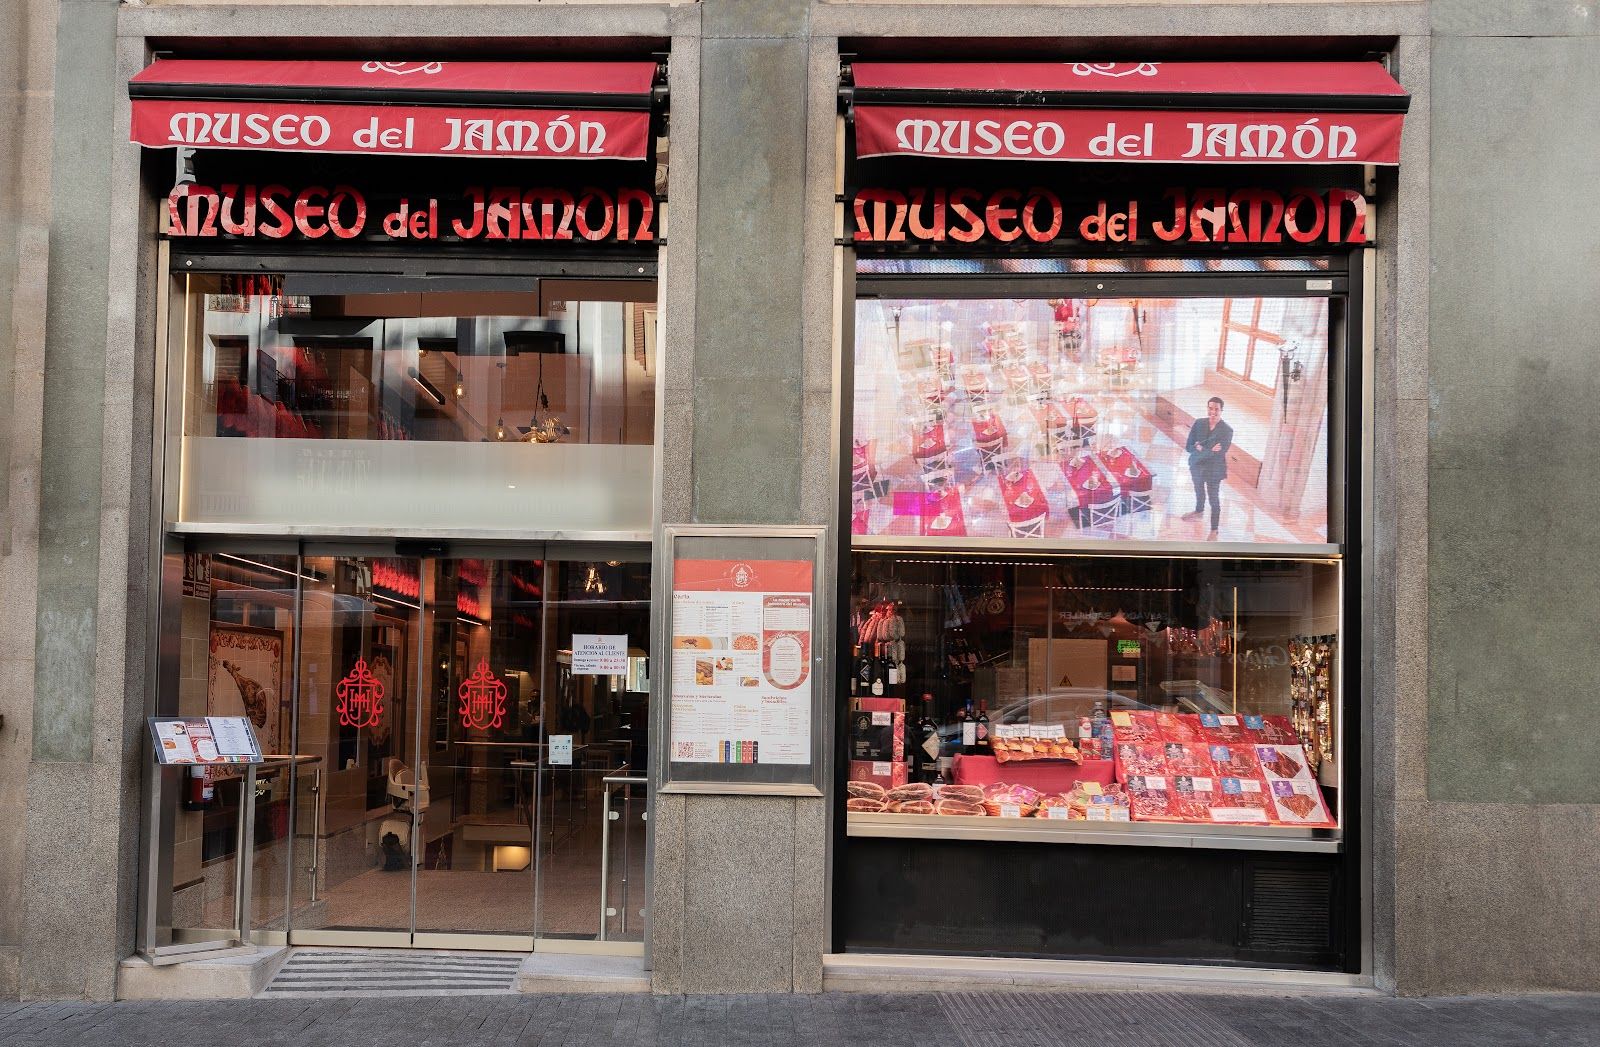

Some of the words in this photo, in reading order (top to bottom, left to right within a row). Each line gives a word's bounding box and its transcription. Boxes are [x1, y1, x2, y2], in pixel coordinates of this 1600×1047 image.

[168, 112, 332, 147] MUSEO
[352, 116, 414, 149] del
[440, 114, 607, 154] JAMÓN
[895, 119, 1066, 156] MUSEO
[1088, 123, 1153, 157] del
[1181, 117, 1358, 159] JAMÓN
[168, 184, 367, 239] MUSEO
[382, 198, 438, 240] del
[853, 187, 1063, 243] MUSEO
[1078, 200, 1138, 242] del
